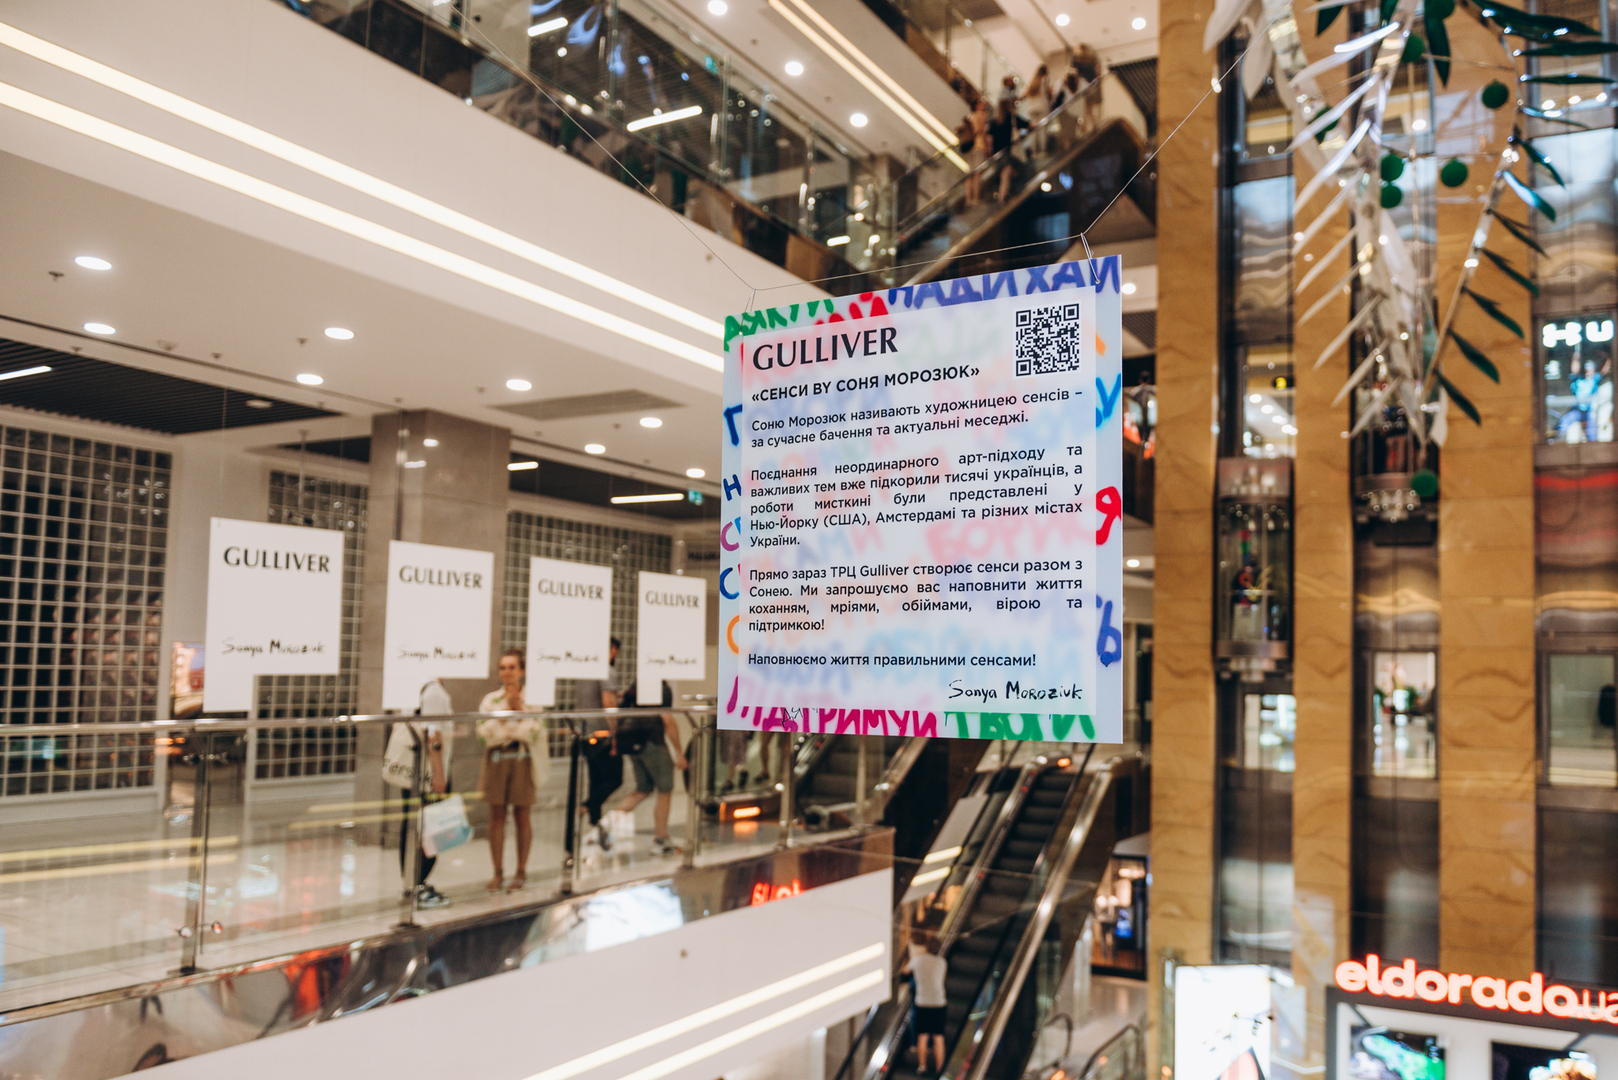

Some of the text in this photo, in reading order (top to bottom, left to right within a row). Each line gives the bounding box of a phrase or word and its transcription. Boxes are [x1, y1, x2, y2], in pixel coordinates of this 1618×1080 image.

[752, 326, 899, 371] GULLIVER
[751, 383, 808, 402] «СЕНСИ
[835, 374, 879, 393] СОНЯ
[883, 363, 980, 387] МОРОЗЮК»
[750, 419, 785, 432] Соню
[788, 412, 847, 428] Морозюк
[849, 404, 921, 421] називають
[924, 394, 1017, 415] художницею
[1021, 387, 1070, 404] сенсів
[750, 409, 1029, 448] за сучасне бачення та актуальні меседжі.
[750, 444, 1083, 481] Поєднання неординарного арт-підходу та
[750, 462, 1083, 498] важливих тем вже підкорили тисячі українців, а
[749, 481, 1083, 516] роботи мисткині були представлені у
[749, 500, 1083, 531] Нью-Йорку (США), Амстердамі та різних містах
[749, 533, 800, 549] України.
[223, 546, 330, 573] GULLIVER
[749, 559, 1083, 583] Прямо зараз ТРЦ Gulliver створює сенси разом з
[399, 565, 483, 588] GULLIVER
[538, 578, 604, 600] GULLIVER
[748, 578, 1082, 598] Сонею. Ми запрошуємо вас наповнити життя
[645, 589, 699, 608] GULLIVER
[748, 596, 1083, 615] коханням, мріями, обіймами, вірою та
[748, 618, 825, 633] підтримкою!
[747, 652, 1036, 668] Наповнюємо життя правильними сенсами!
[947, 678, 998, 704] Sonya
